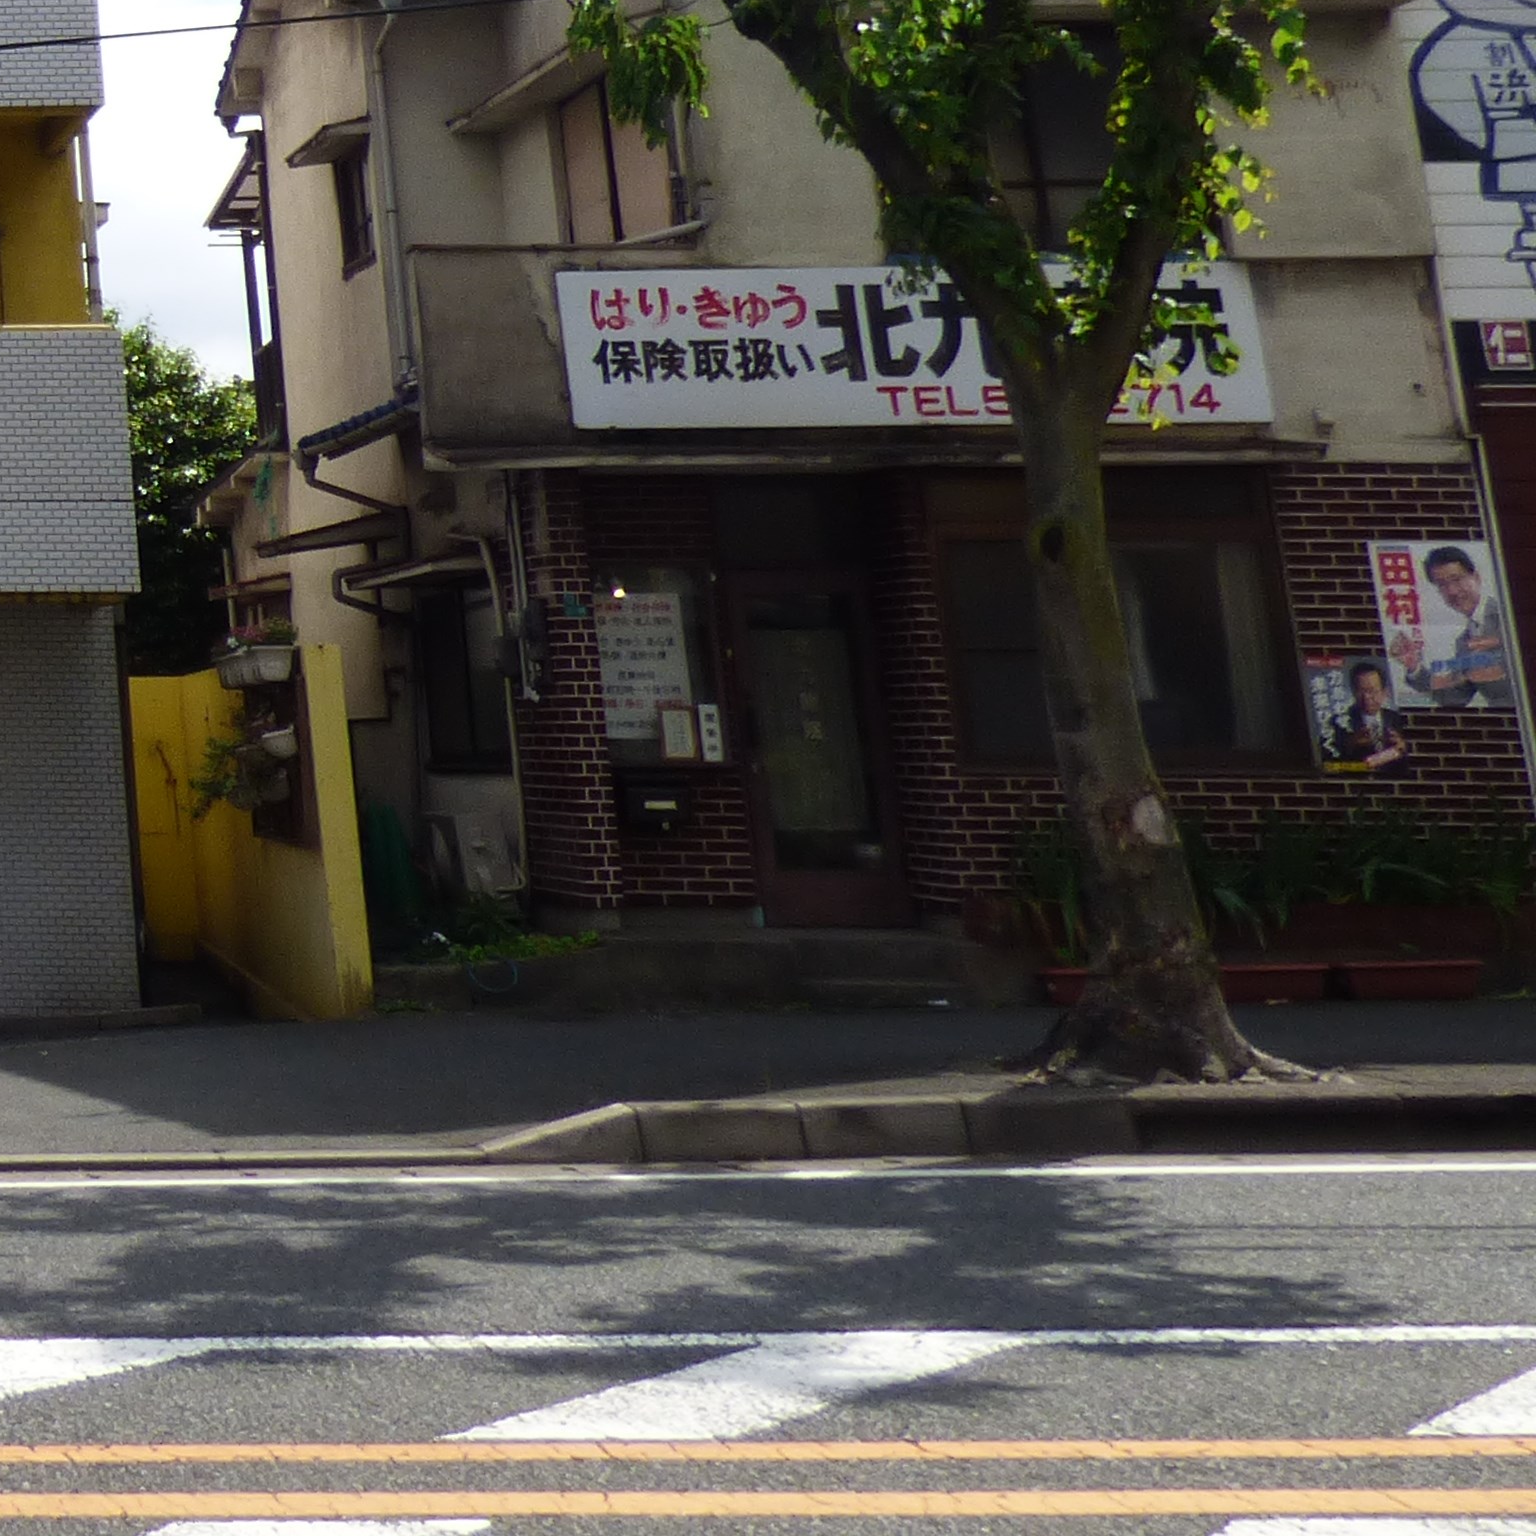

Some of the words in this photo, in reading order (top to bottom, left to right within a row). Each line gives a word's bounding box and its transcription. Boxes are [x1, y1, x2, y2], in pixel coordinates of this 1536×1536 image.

[590, 284, 808, 331] はり・きゅう
[592, 338, 816, 385] 保険取扱い
